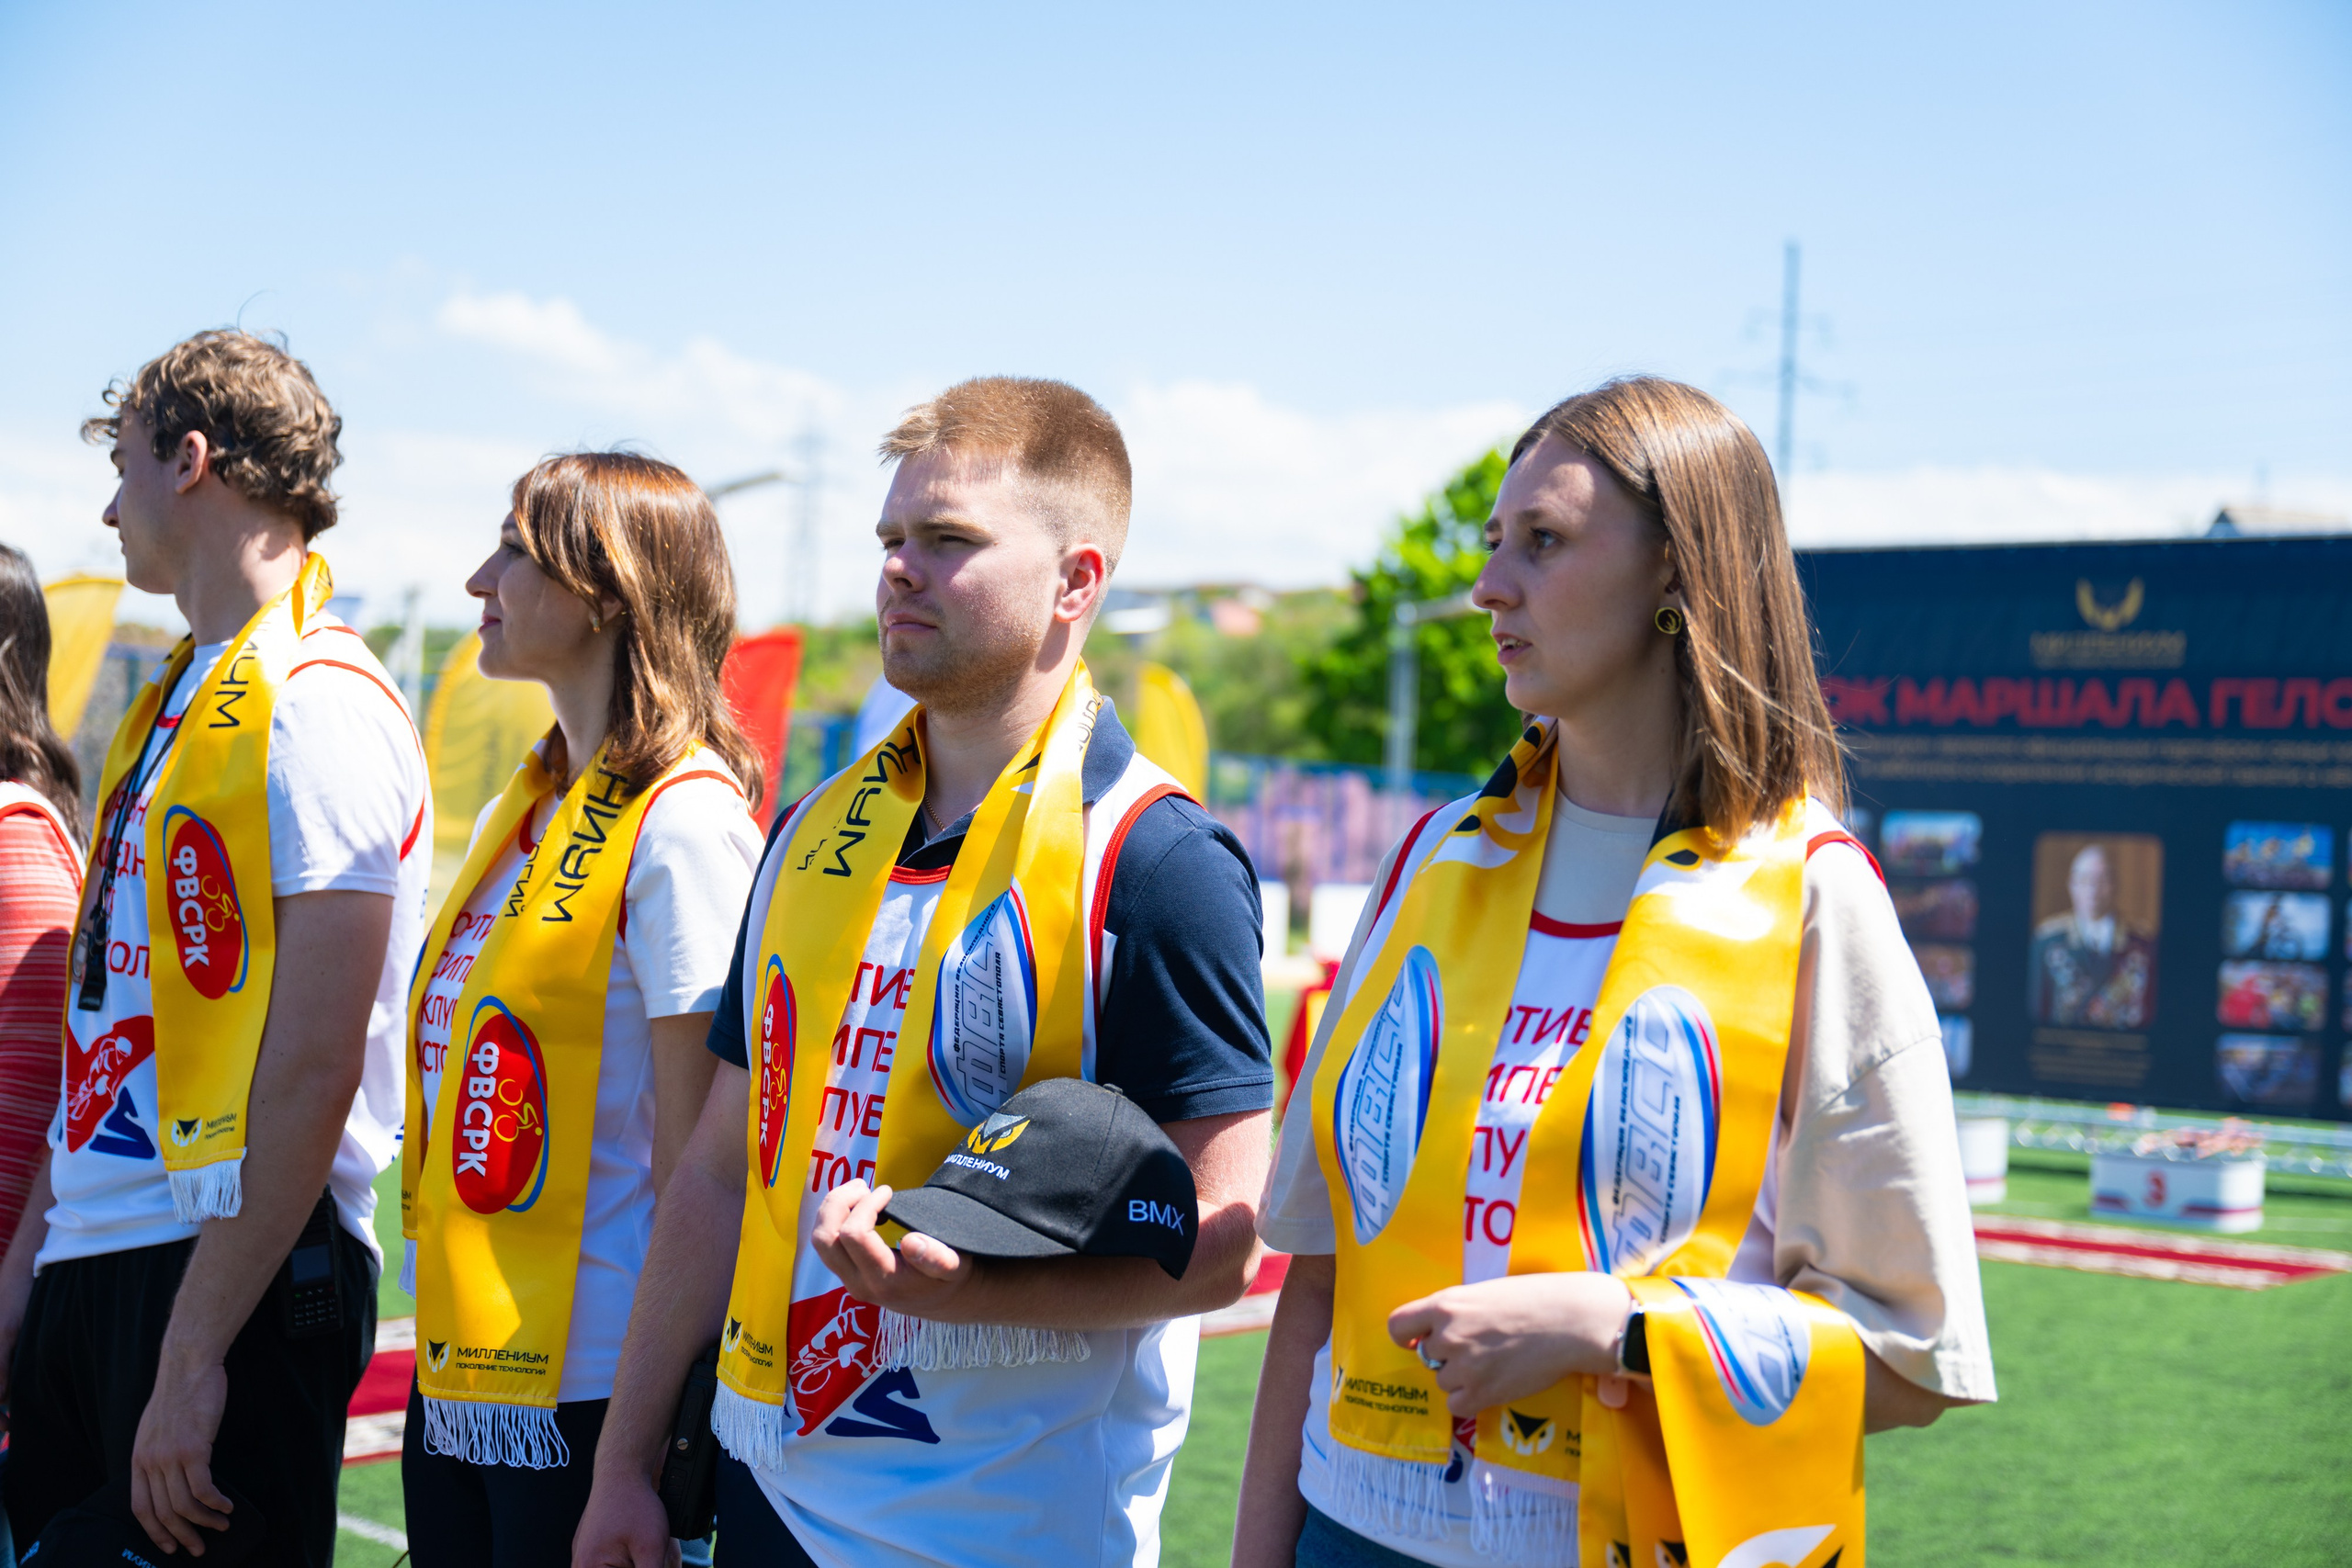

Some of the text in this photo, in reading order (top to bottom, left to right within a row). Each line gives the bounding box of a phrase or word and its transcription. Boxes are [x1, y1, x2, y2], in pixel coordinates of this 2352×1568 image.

[1894, 677, 2199, 728] МАРШАЛА
[173, 844, 210, 969] ФВСРК
[953, 903, 996, 1054] ФЕДЕРАЦИЯ ВЕЛОСИПЕДНОГО
[995, 952, 1007, 1075] СПОРТА СЕВАСТОПОЛЯ
[457, 1042, 500, 1178] ФВСРК
[760, 1004, 775, 1148] ФВСРК
[1128, 1200, 1185, 1236] BMX
[456, 1362, 546, 1376] ПОКОЛЕНИЕ ТЕХНОЛОГИЙ
[457, 1347, 548, 1365] МИЛЛЕНИУМ
